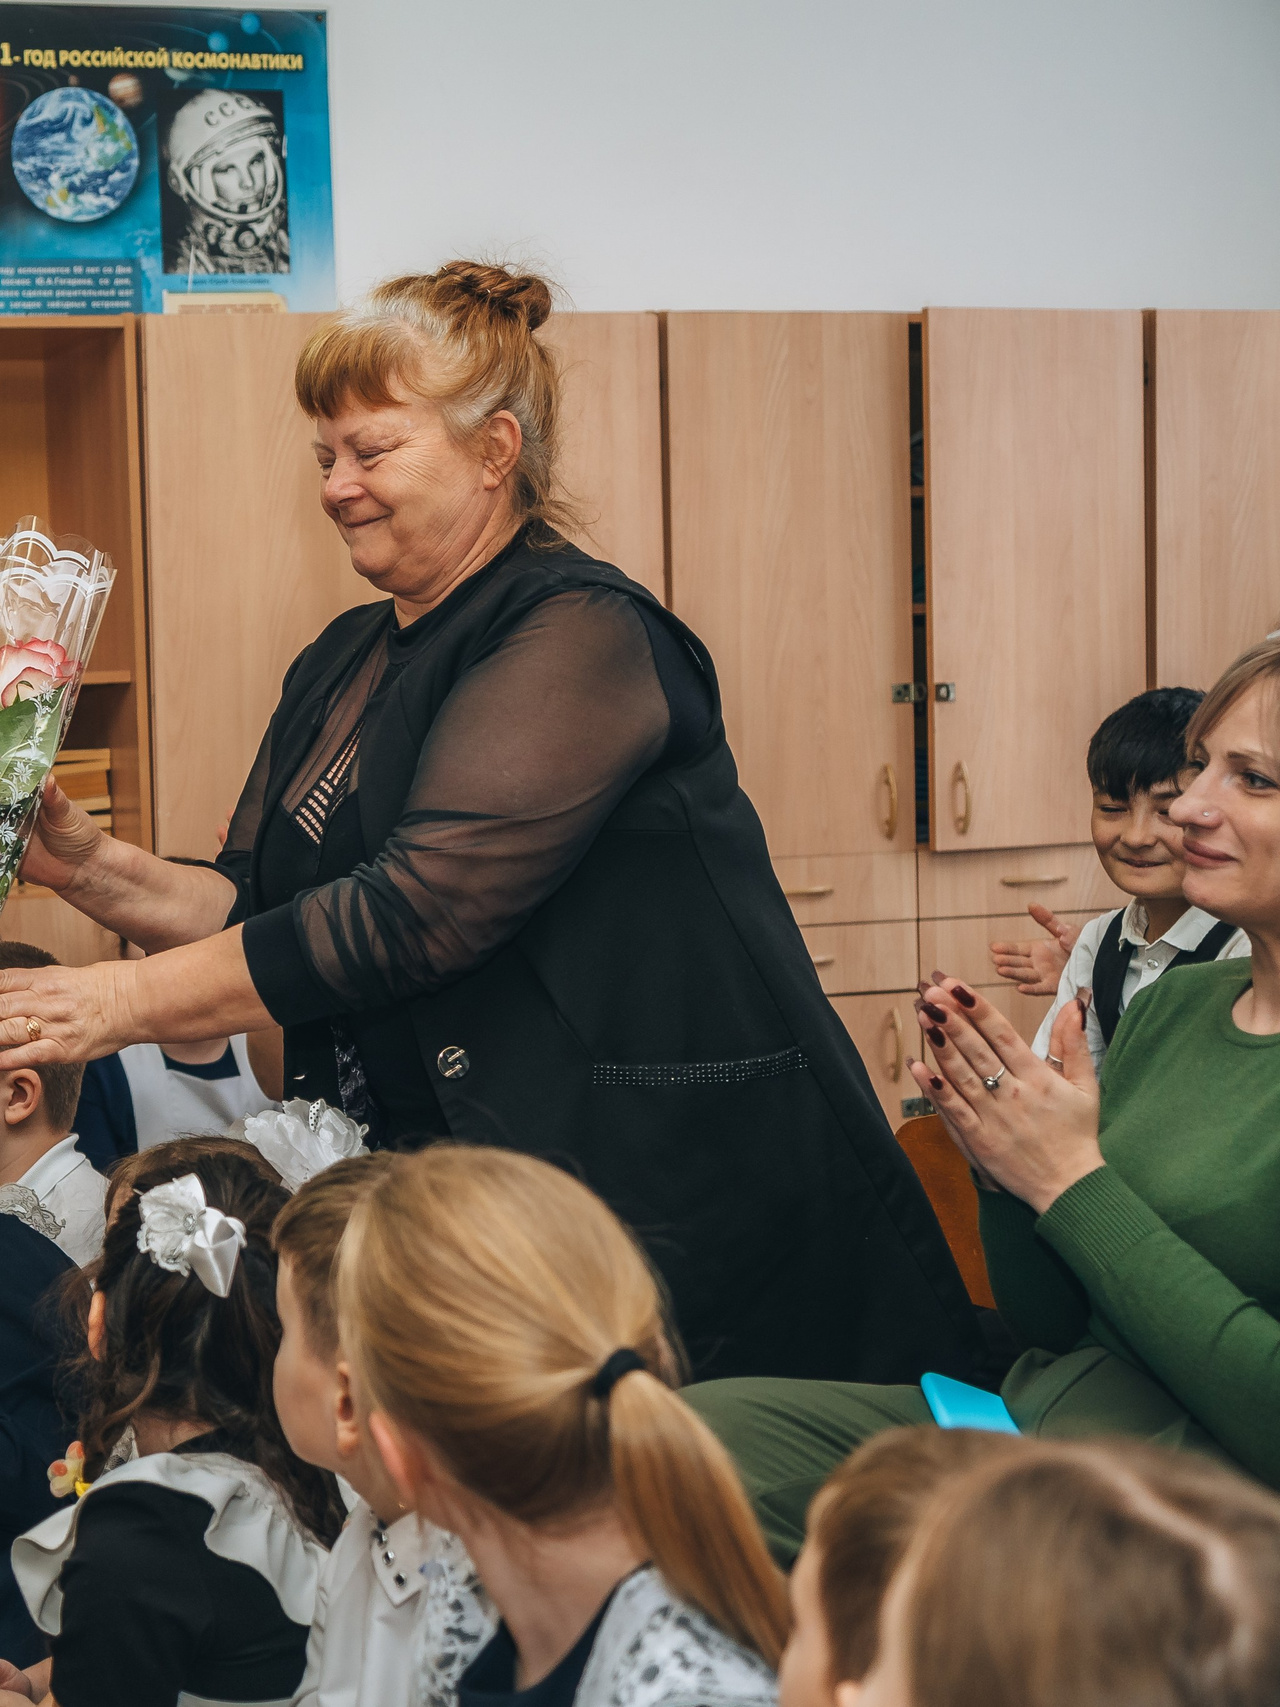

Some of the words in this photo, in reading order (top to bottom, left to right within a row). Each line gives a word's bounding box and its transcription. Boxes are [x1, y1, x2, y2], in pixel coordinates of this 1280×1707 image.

[23, 49, 57, 69] ГОД
[58, 46, 169, 69] РОССИЙСКОЙ
[170, 52, 304, 71] КОСМОНАВТИКИ
